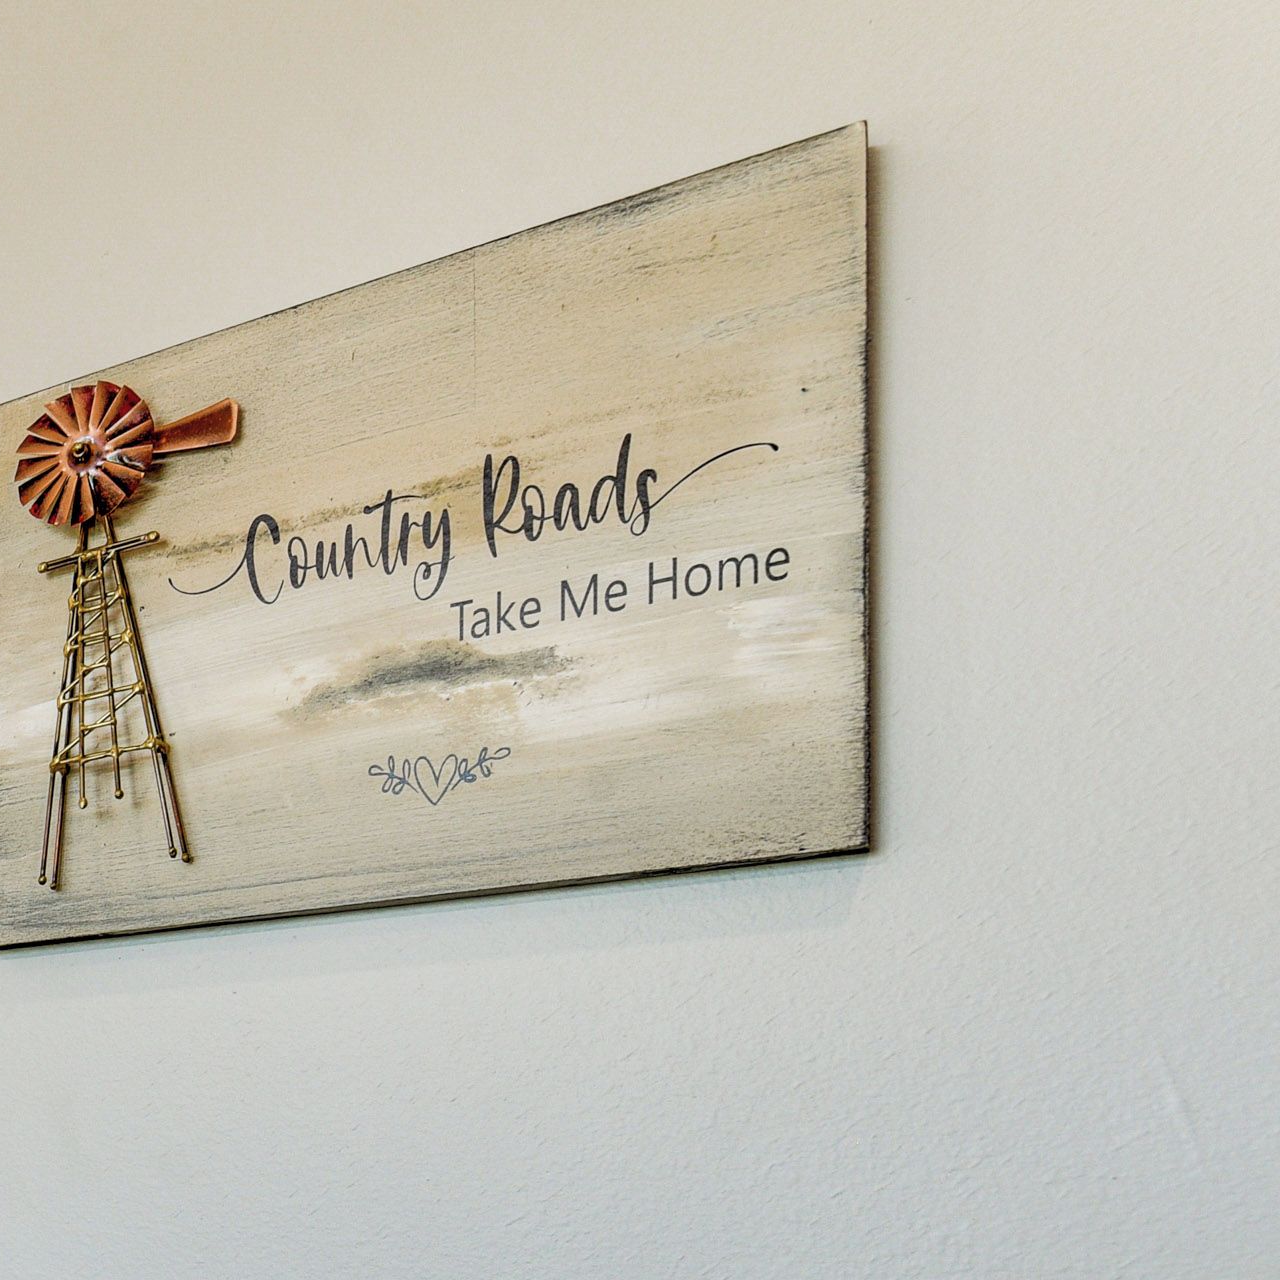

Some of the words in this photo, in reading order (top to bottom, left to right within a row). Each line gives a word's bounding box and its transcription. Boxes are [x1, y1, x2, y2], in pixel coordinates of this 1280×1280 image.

[168, 487, 452, 605] Country
[482, 432, 780, 556] Roads
[450, 586, 541, 643] Take
[558, 572, 629, 620] Me
[647, 543, 792, 606] Home
